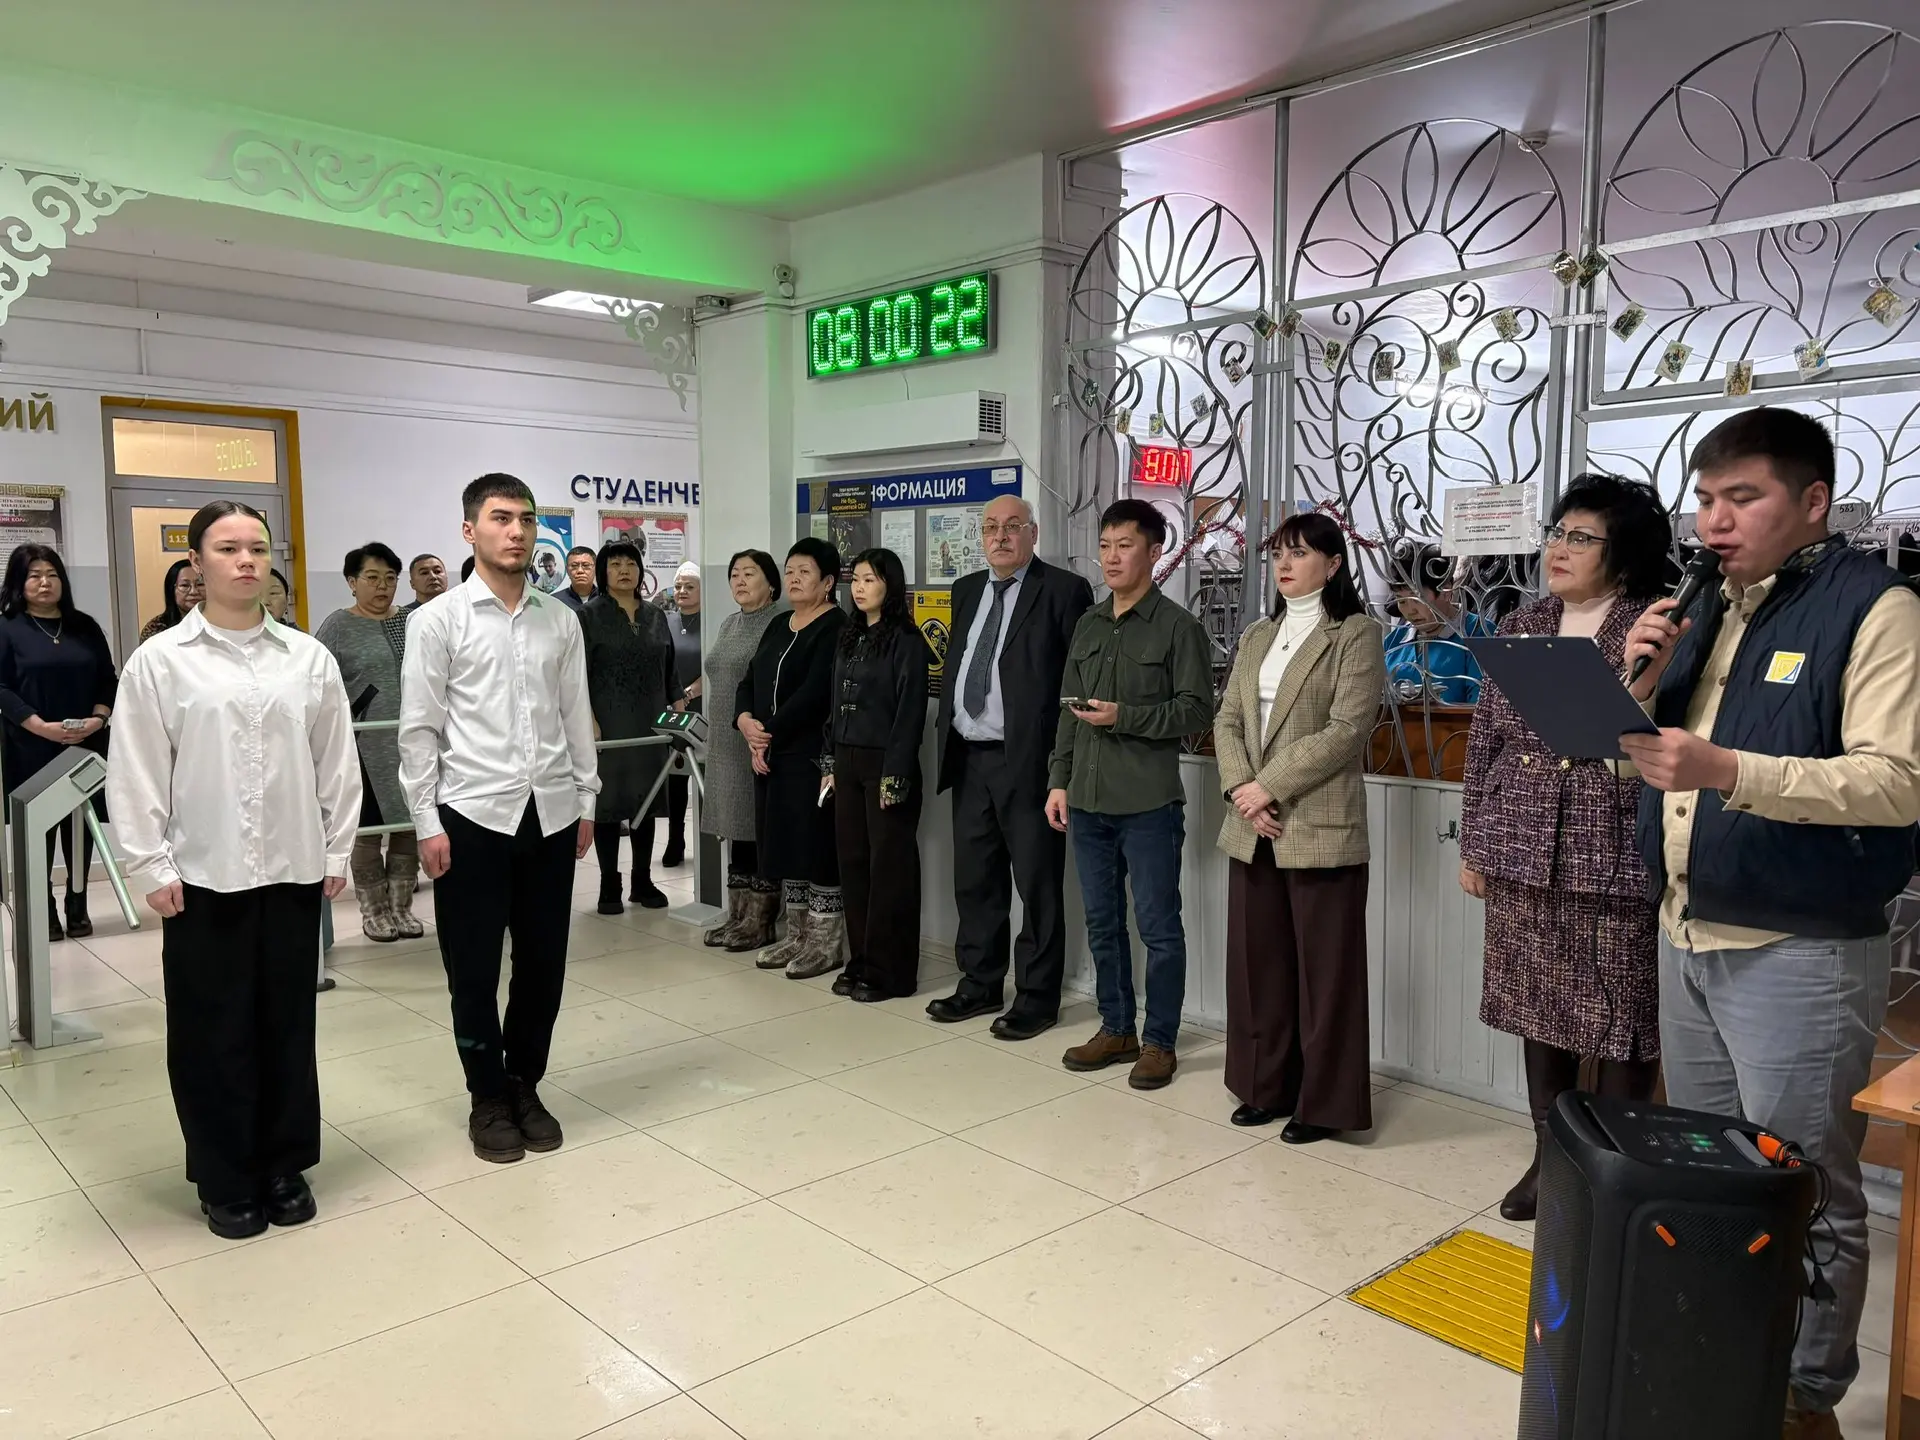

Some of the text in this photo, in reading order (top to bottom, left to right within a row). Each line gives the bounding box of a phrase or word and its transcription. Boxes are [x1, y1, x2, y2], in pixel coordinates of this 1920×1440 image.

[571, 474, 700, 505] СТУДЕНЧЕ
[871, 477, 966, 502] НФОРМАЦИЯ
[168, 535, 188, 543] 113
